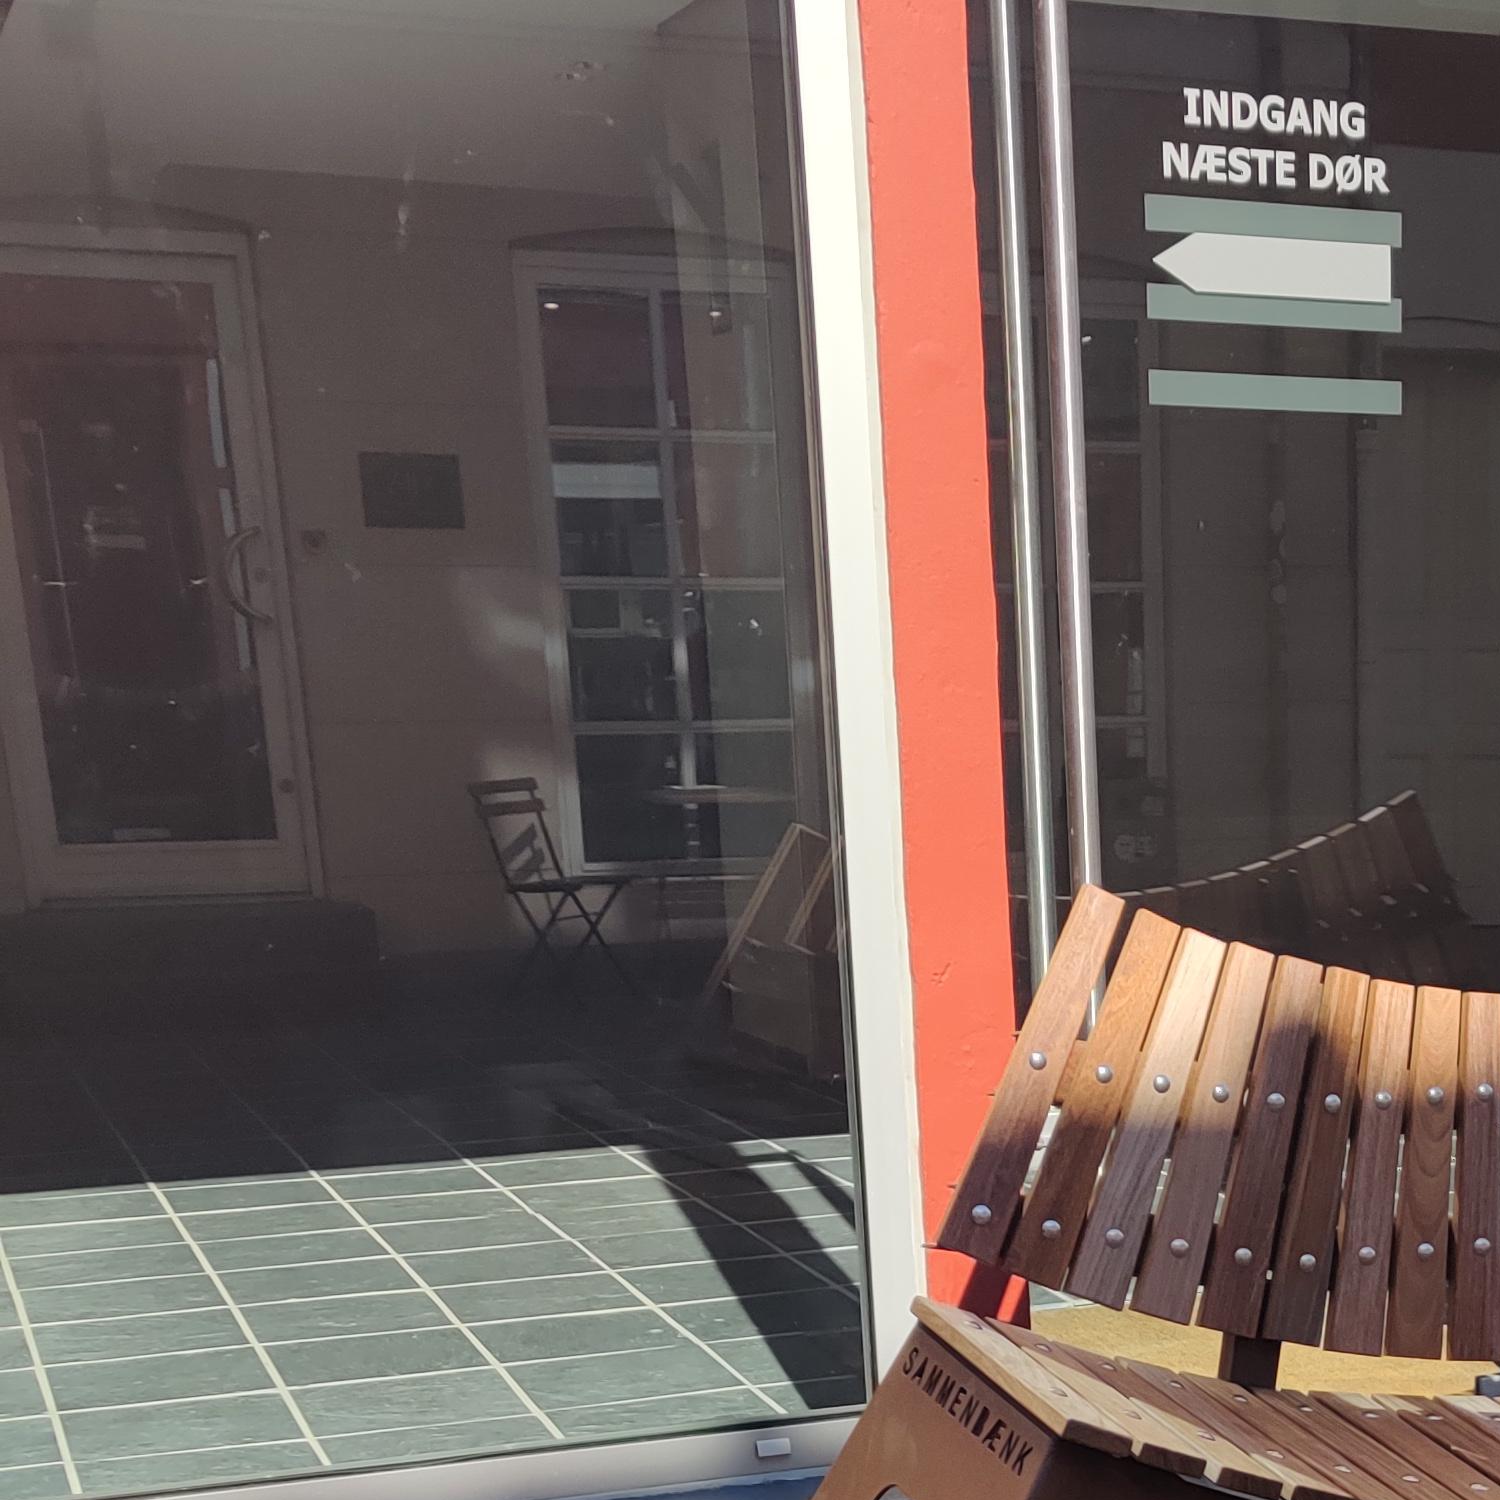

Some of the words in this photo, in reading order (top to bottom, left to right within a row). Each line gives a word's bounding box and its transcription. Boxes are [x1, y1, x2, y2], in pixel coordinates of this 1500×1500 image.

[1183, 86, 1366, 139] INDGANG
[1162, 140, 1297, 189] NÆSTE
[1308, 153, 1391, 194] DØR
